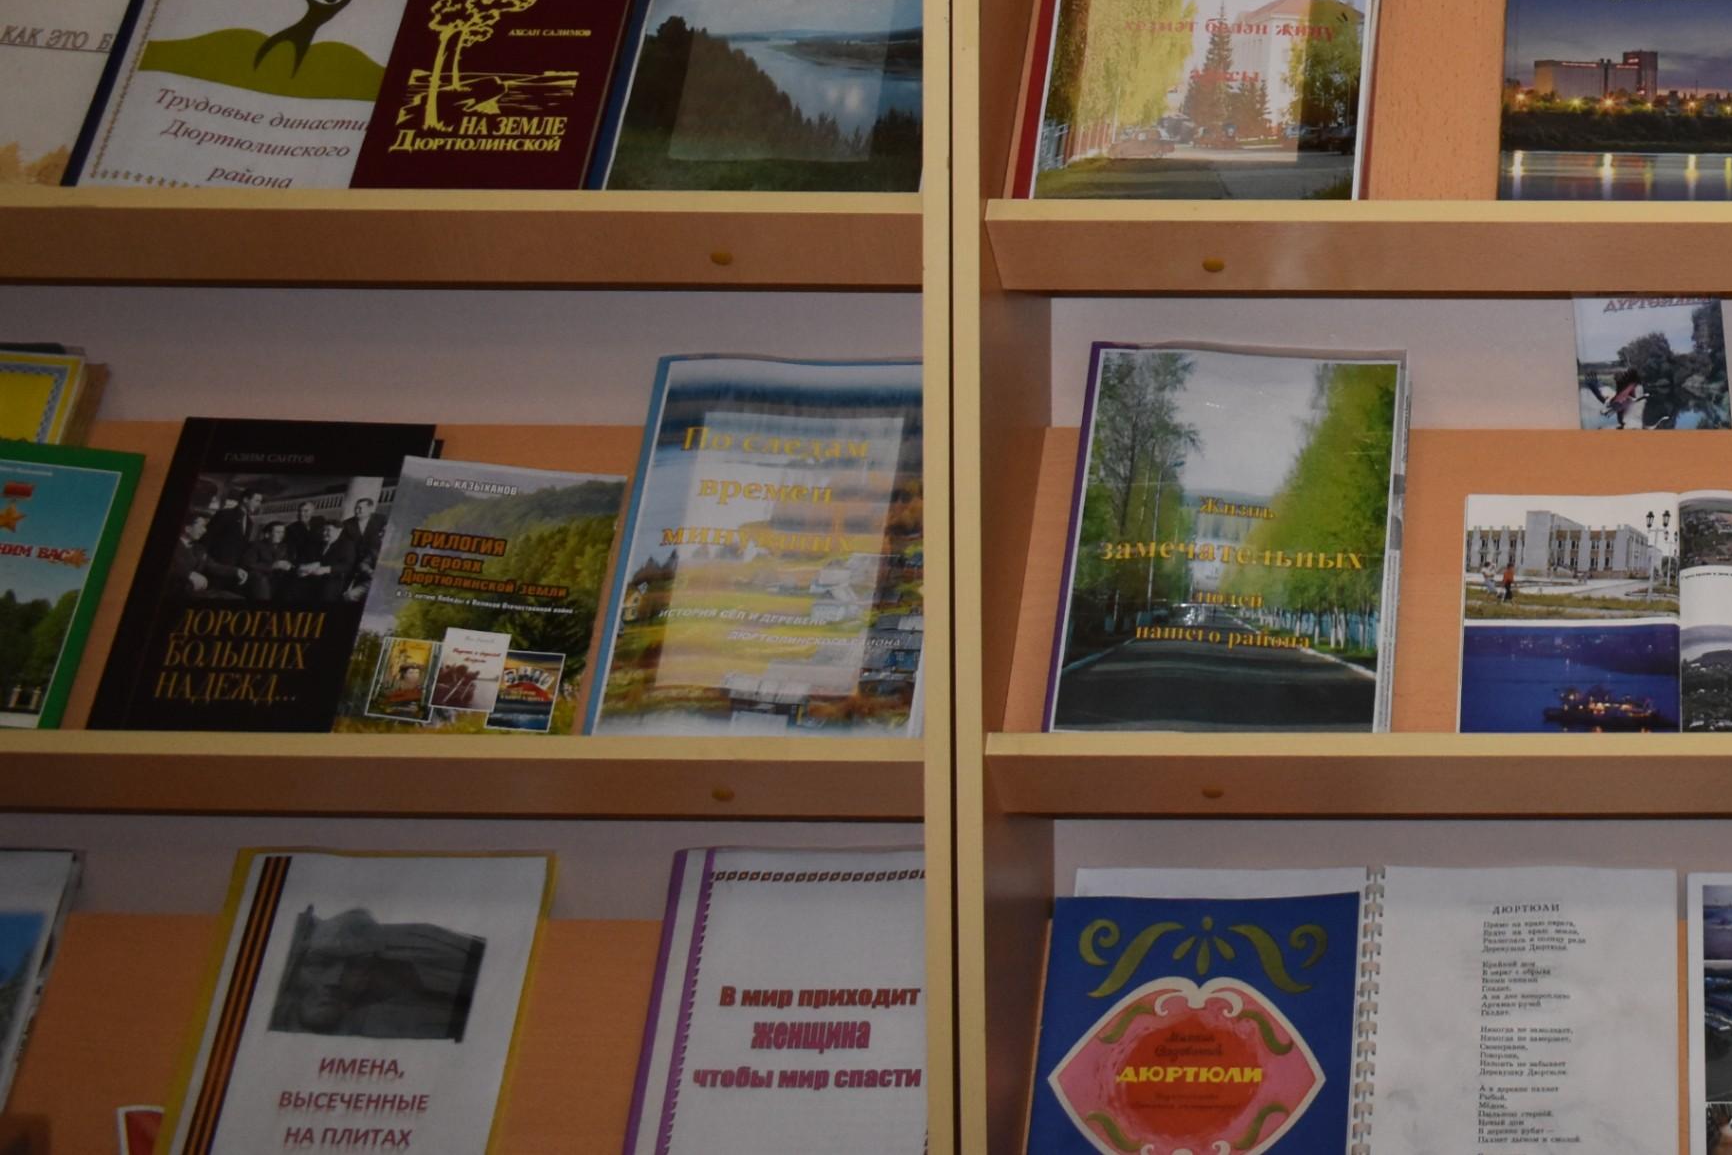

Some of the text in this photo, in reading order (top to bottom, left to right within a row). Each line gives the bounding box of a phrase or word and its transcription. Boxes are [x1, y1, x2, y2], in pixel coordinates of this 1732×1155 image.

[0, 25, 89, 51] КАК ЭТО
[543, 28, 592, 37] САЛИМОВ
[156, 87, 265, 125] Трудовые
[160, 119, 351, 159] Дюртюлинского
[458, 116, 567, 137] НА ЗЕМЛЕ
[206, 164, 293, 189] района
[683, 425, 871, 459] По следам
[425, 478, 518, 496] Виль КАЗЫХАНОВ
[696, 477, 834, 506] времен
[1200, 496, 1277, 521] Жизнь
[410, 529, 506, 557] ТРИЛОГИЯ
[660, 526, 855, 553] минувших
[405, 553, 483, 575] о героях
[1100, 540, 1364, 570] замечательных
[400, 568, 515, 596] Дюртюлинской
[519, 582, 568, 599] земли
[169, 609, 326, 643] ДОРОГАМИ
[659, 607, 717, 621] ИСТОРИЯ
[749, 612, 756, 623] И
[1136, 624, 1310, 650] нашего района
[163, 637, 307, 669] БОЛЬШИХ
[154, 670, 297, 703] НАДЕЖД...
[1492, 903, 1560, 915] ДЮРТЮЛИ
[719, 985, 921, 1010] В мир приходит
[751, 1020, 872, 1055] женщина
[318, 1056, 405, 1080] ИМЕНА,
[692, 1066, 922, 1091] чтобы мир спасти
[1116, 1066, 1263, 1083] ДЮРТЮЛИ
[278, 1090, 430, 1114] ВЫСЕЧЕННЫЕ
[283, 1126, 412, 1148] НА ПЛИТАХ
